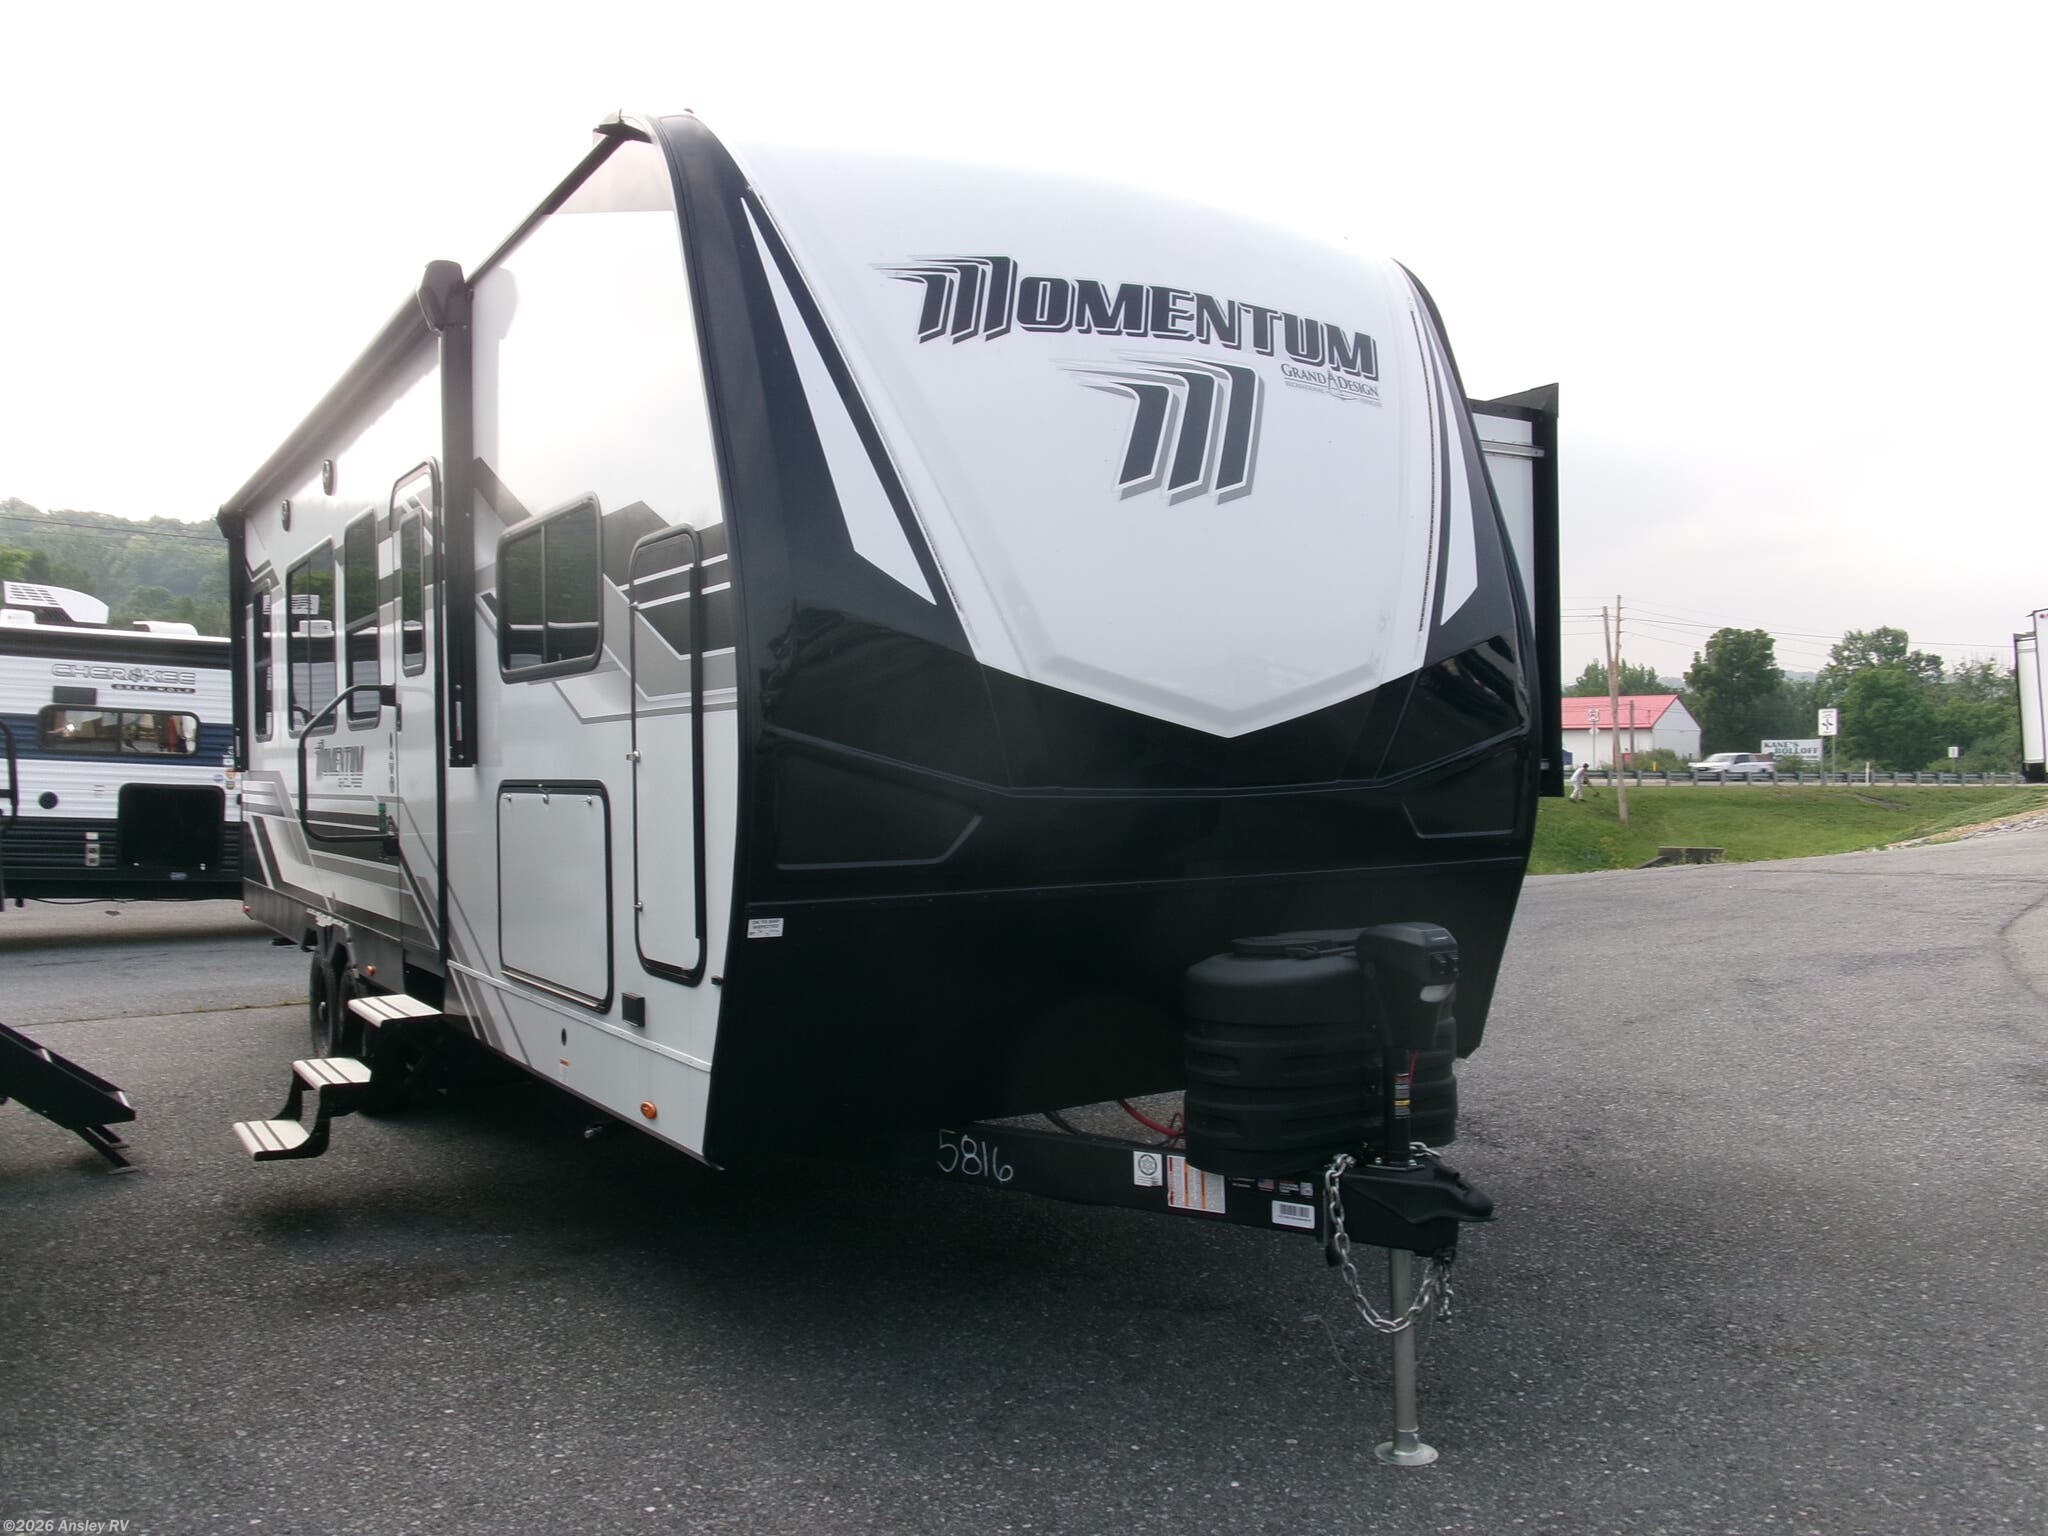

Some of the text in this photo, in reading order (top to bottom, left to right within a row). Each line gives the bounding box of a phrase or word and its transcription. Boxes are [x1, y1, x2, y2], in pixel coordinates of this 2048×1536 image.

[869, 255, 1379, 381] MOMENTUM
[1281, 364, 1326, 384] GRAND
[1338, 376, 1379, 397] DESIGN
[937, 1128, 1014, 1182] 5816
